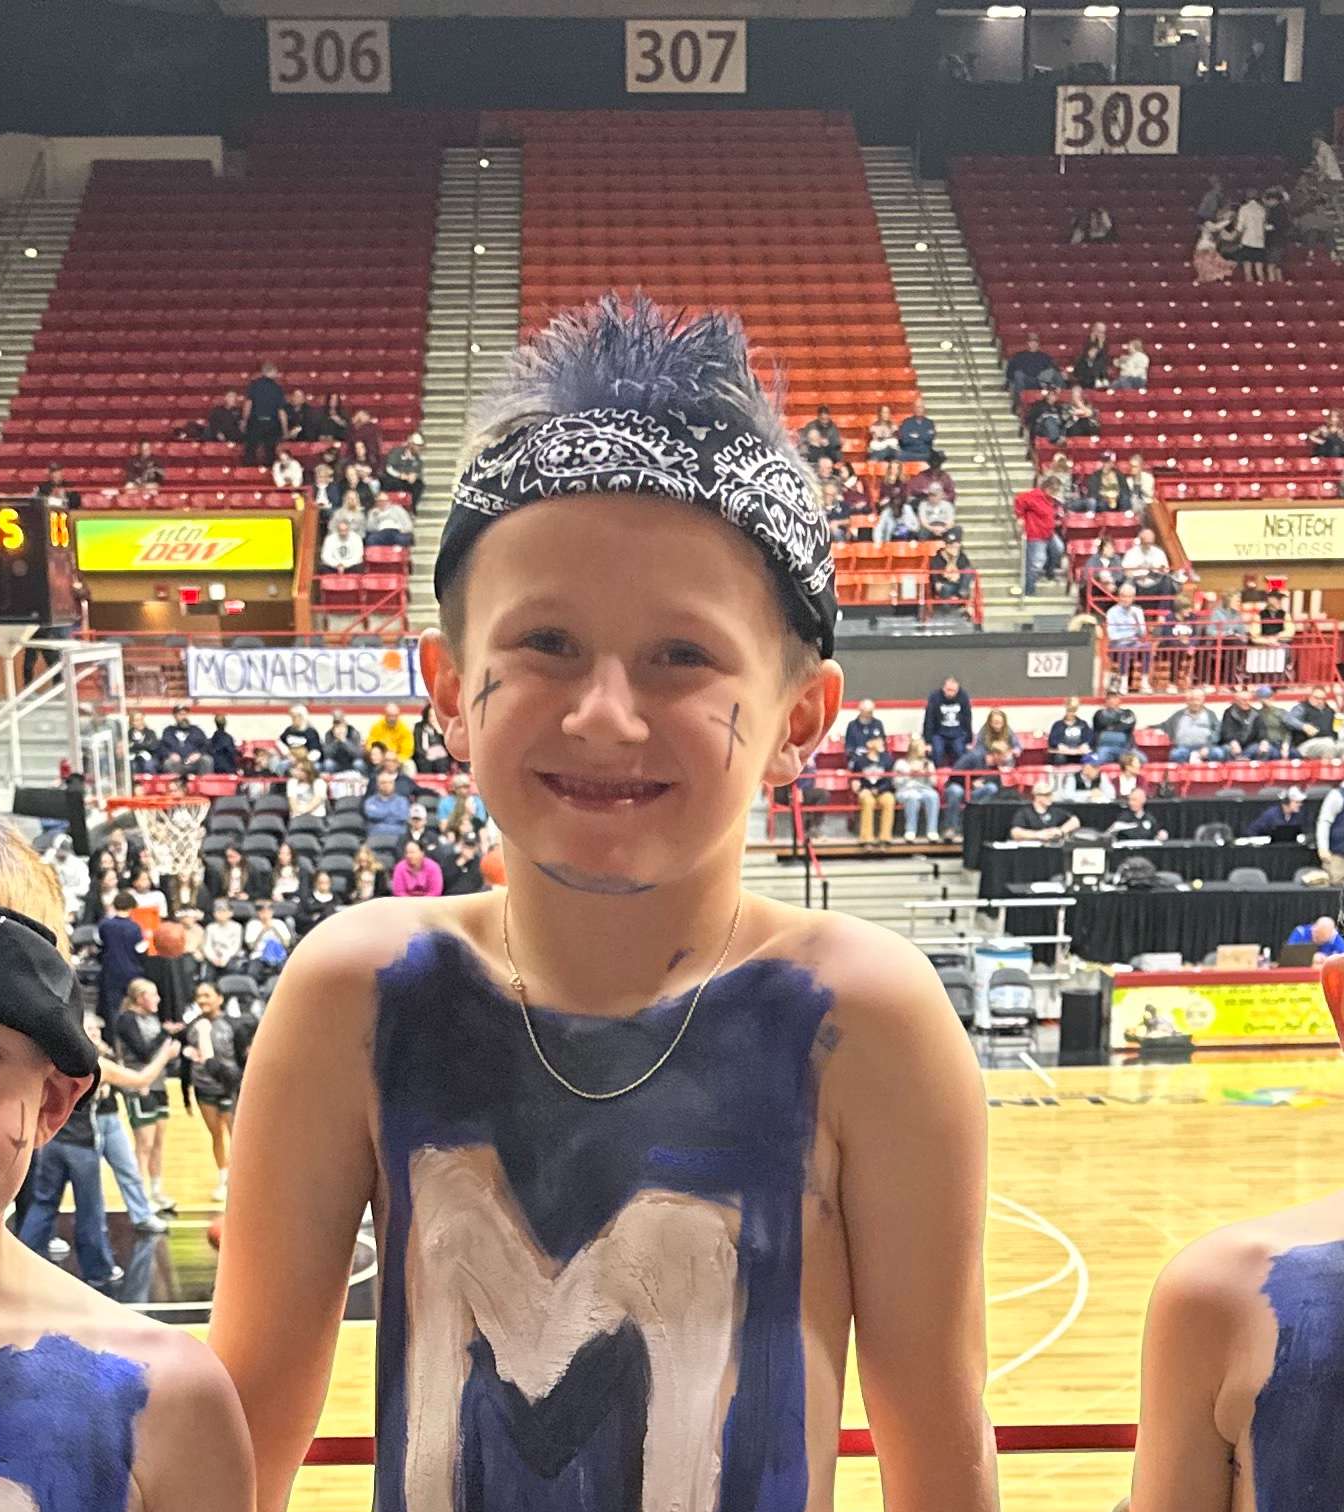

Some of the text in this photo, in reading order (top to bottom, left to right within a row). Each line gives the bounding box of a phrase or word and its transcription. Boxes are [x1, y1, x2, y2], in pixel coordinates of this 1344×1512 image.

[278, 29, 381, 83] 306
[635, 29, 737, 83] 307
[1063, 92, 1169, 147] 308
[194, 651, 381, 694] MONARCHS
[1033, 655, 1064, 673] 207
